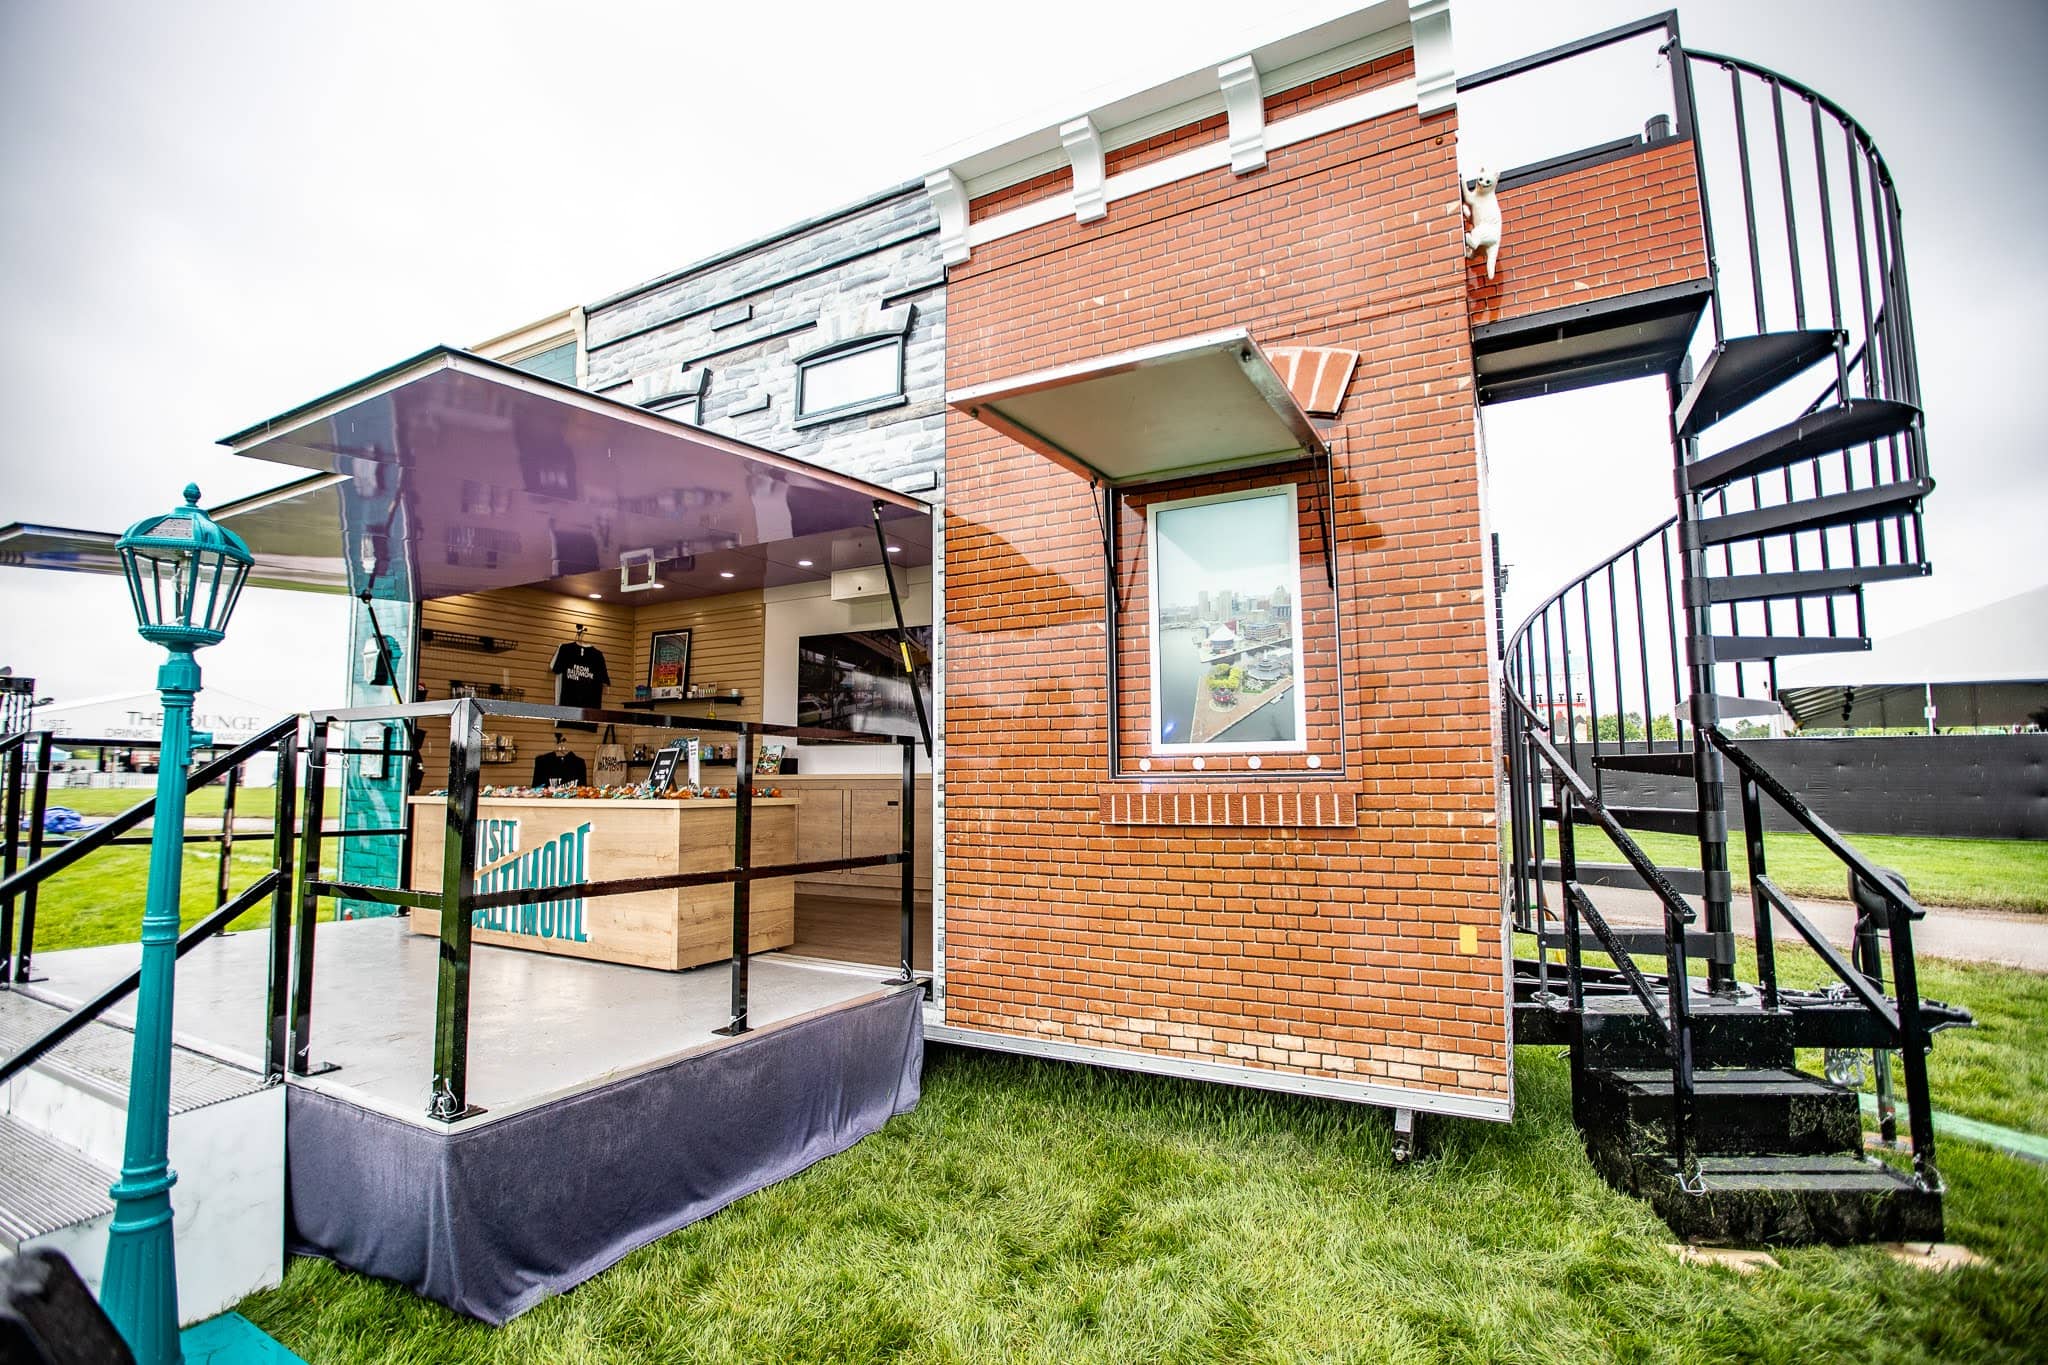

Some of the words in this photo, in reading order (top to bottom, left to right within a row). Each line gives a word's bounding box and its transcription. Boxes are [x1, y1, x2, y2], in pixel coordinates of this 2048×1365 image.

[573, 664, 590, 672] FROM
[125, 711, 164, 727] THE
[103, 728, 154, 739] DRINKS
[601, 756, 617, 764] FROM
